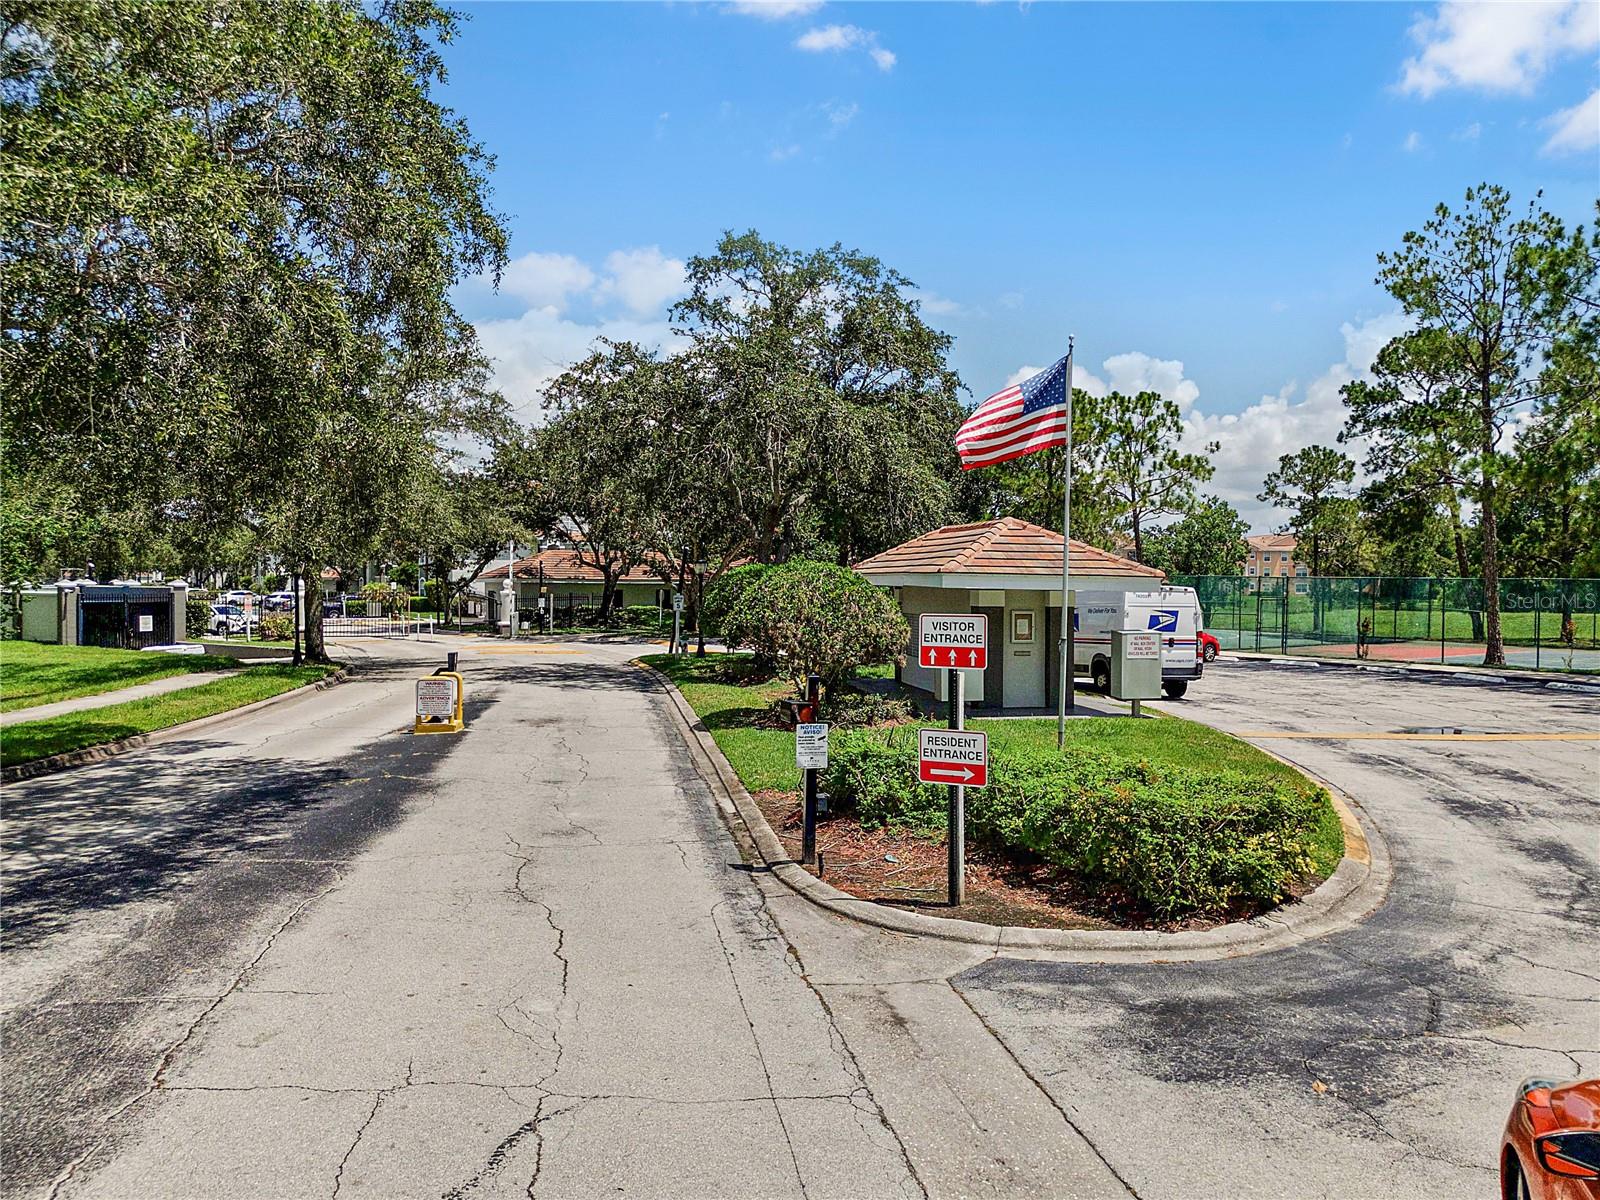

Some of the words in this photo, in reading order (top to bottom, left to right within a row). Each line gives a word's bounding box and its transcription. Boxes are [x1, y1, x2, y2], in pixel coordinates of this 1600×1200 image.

[932, 622, 975, 631] VISITOR
[924, 634, 983, 644] ENTRANCE
[927, 736, 978, 748] RESIDENT
[923, 748, 983, 761] ENTRANCE
